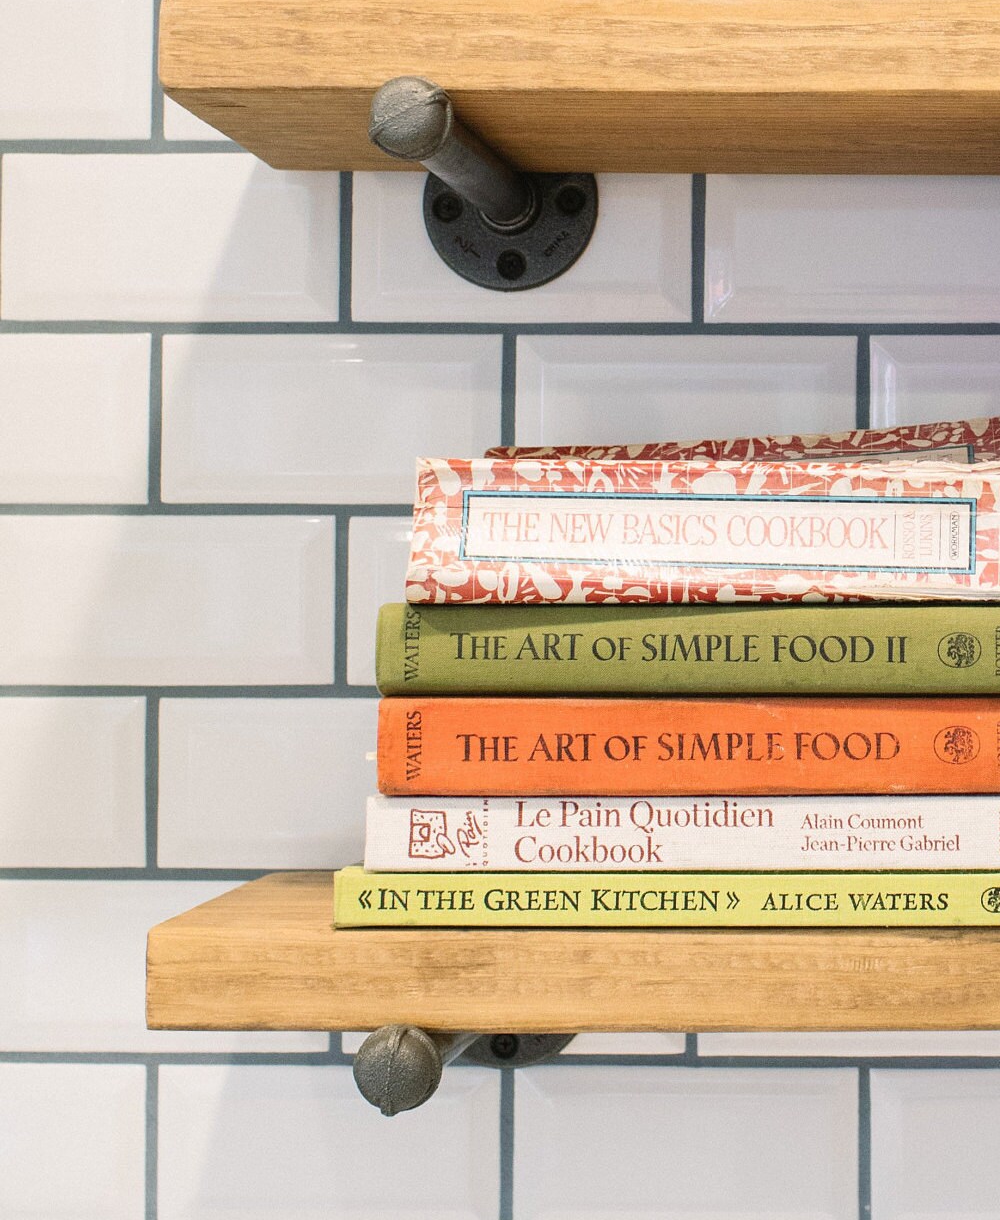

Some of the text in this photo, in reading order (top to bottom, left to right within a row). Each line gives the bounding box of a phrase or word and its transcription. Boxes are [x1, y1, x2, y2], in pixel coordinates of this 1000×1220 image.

[483, 512, 888, 549] THE NEW BASICS COOKBOOK
[920, 515, 932, 555] LUKINS
[951, 515, 959, 556] WORKMAN
[404, 611, 422, 682] WATERS
[450, 632, 907, 663] THE ART OF SIMPLE FOOD II
[406, 711, 421, 780] WATERS
[456, 733, 900, 762] THE ART OF SIMPLE FOOD
[513, 800, 774, 833] Le Pain Quotidien
[801, 813, 924, 830] Alain Coumont
[515, 836, 662, 862] Cookbook
[800, 835, 959, 852] Jean-Pierre Gabriel
[417, 890, 474, 910] THE
[484, 889, 581, 911] GREEN
[761, 893, 948, 911] ALICE WATERS
